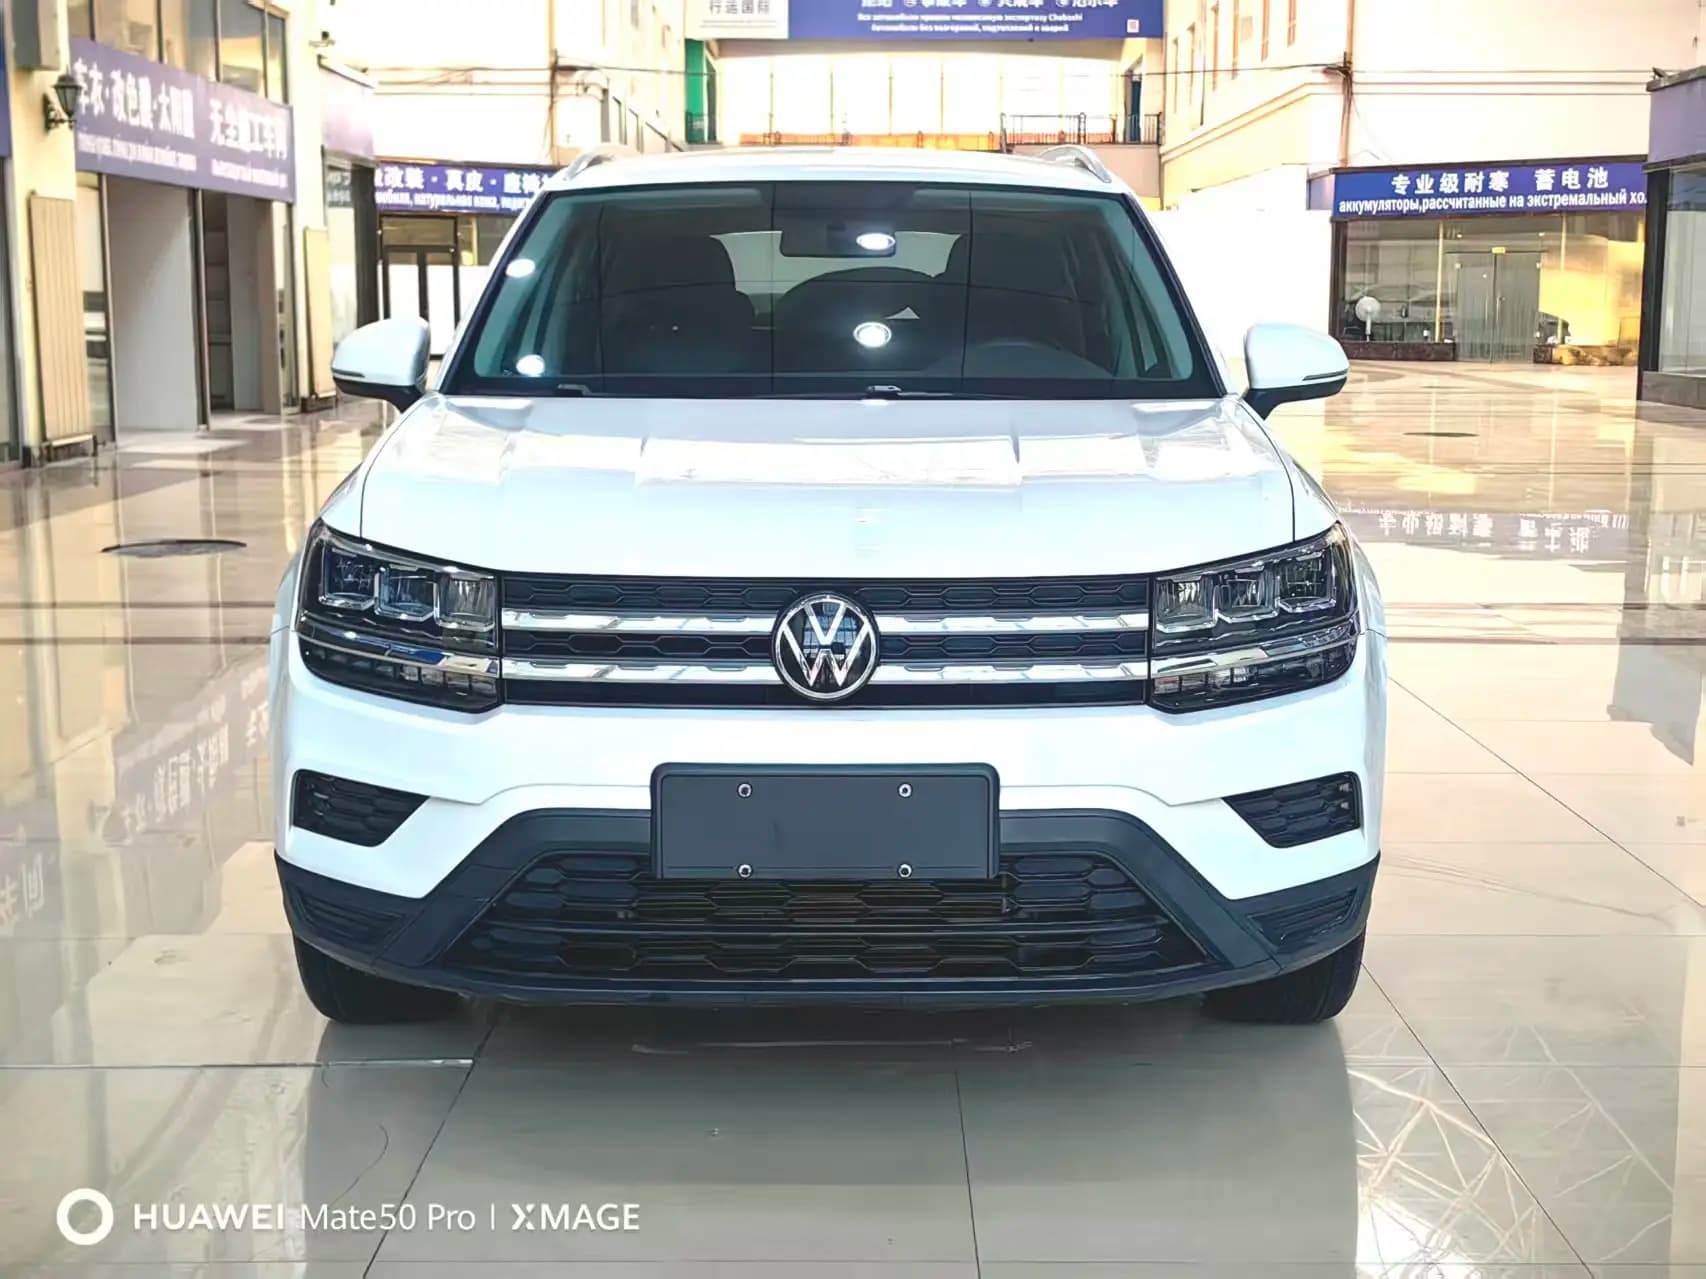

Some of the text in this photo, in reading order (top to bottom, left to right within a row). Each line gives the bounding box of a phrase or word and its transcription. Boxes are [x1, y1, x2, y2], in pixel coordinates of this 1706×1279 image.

[1391, 166, 1609, 196] 专业级耐寒 蓄电池
[1508, 195, 1524, 208] на
[1526, 188, 1628, 210] экстремальный
